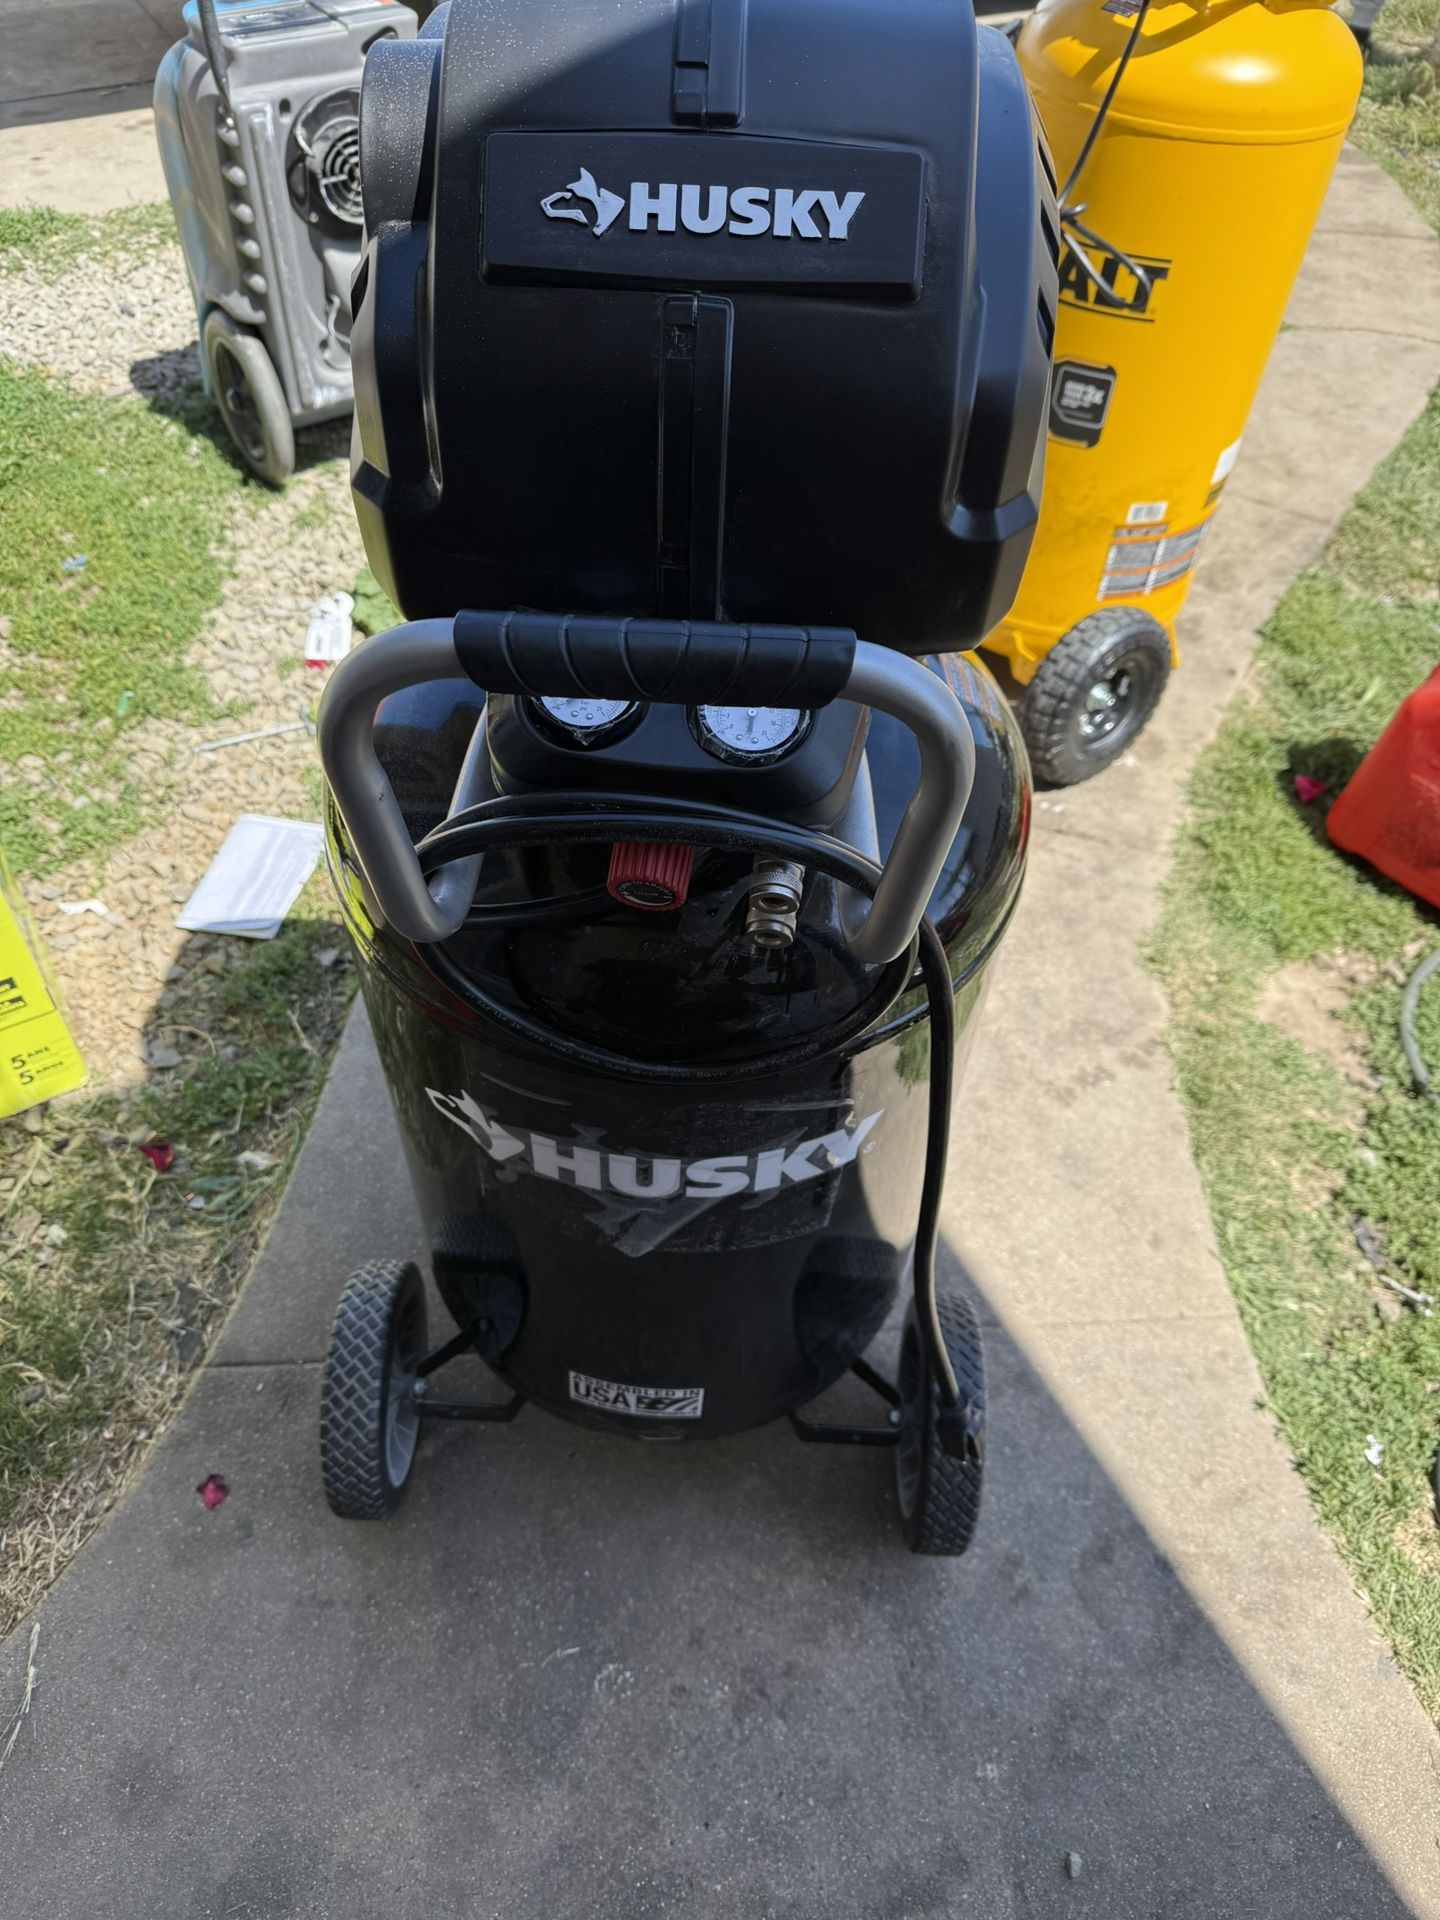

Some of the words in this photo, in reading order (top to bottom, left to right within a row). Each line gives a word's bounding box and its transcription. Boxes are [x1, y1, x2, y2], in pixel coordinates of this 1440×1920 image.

[629, 182, 865, 240] HUSKY
[530, 1109, 885, 1199] HUSKY
[574, 1380, 631, 1408] USA
